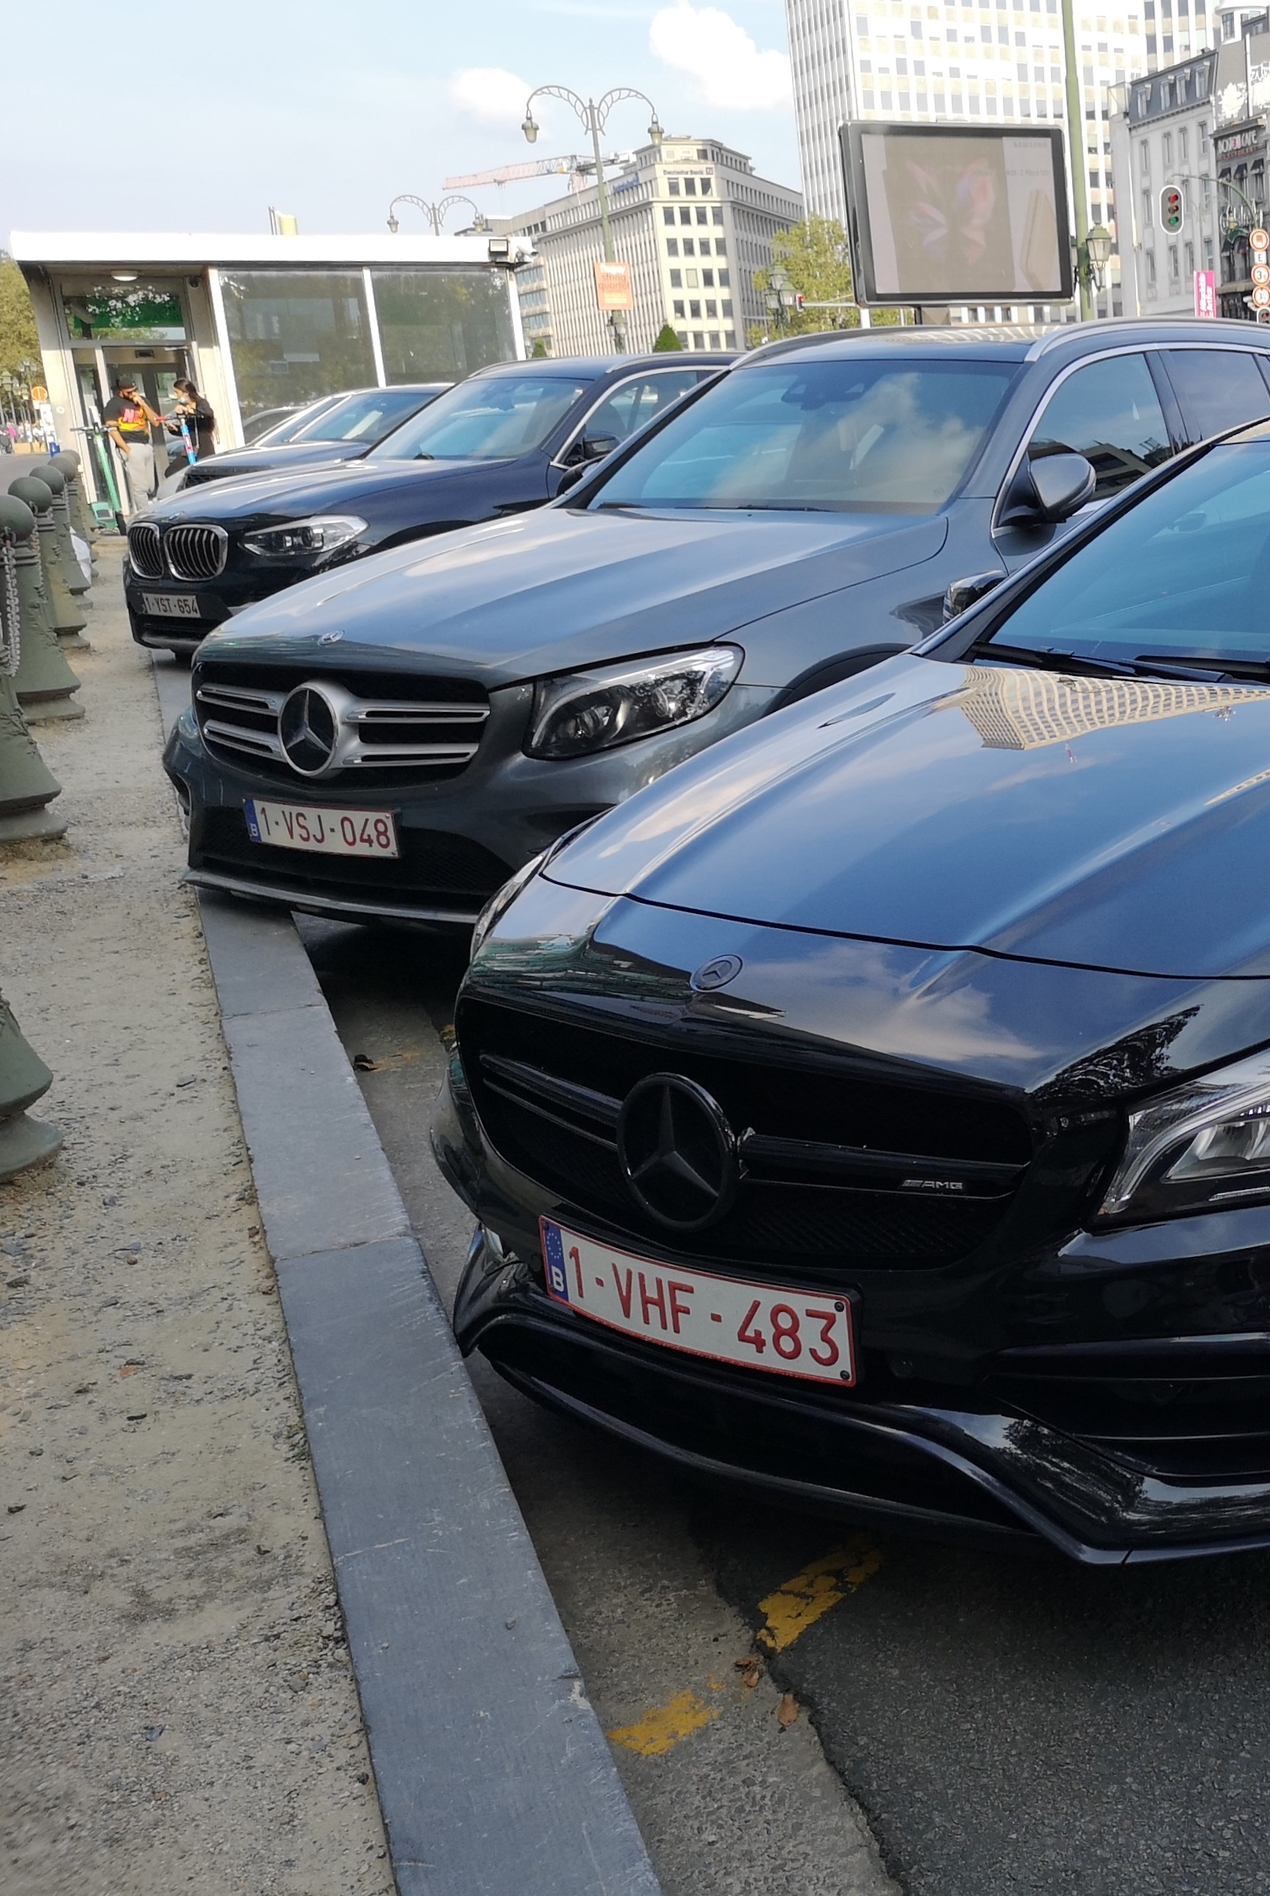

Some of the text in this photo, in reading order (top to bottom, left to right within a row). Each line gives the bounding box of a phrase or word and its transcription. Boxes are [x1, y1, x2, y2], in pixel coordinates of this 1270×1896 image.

[250, 823, 259, 837] B
[921, 1180, 963, 1190] AMG
[550, 1265, 565, 1293] B
